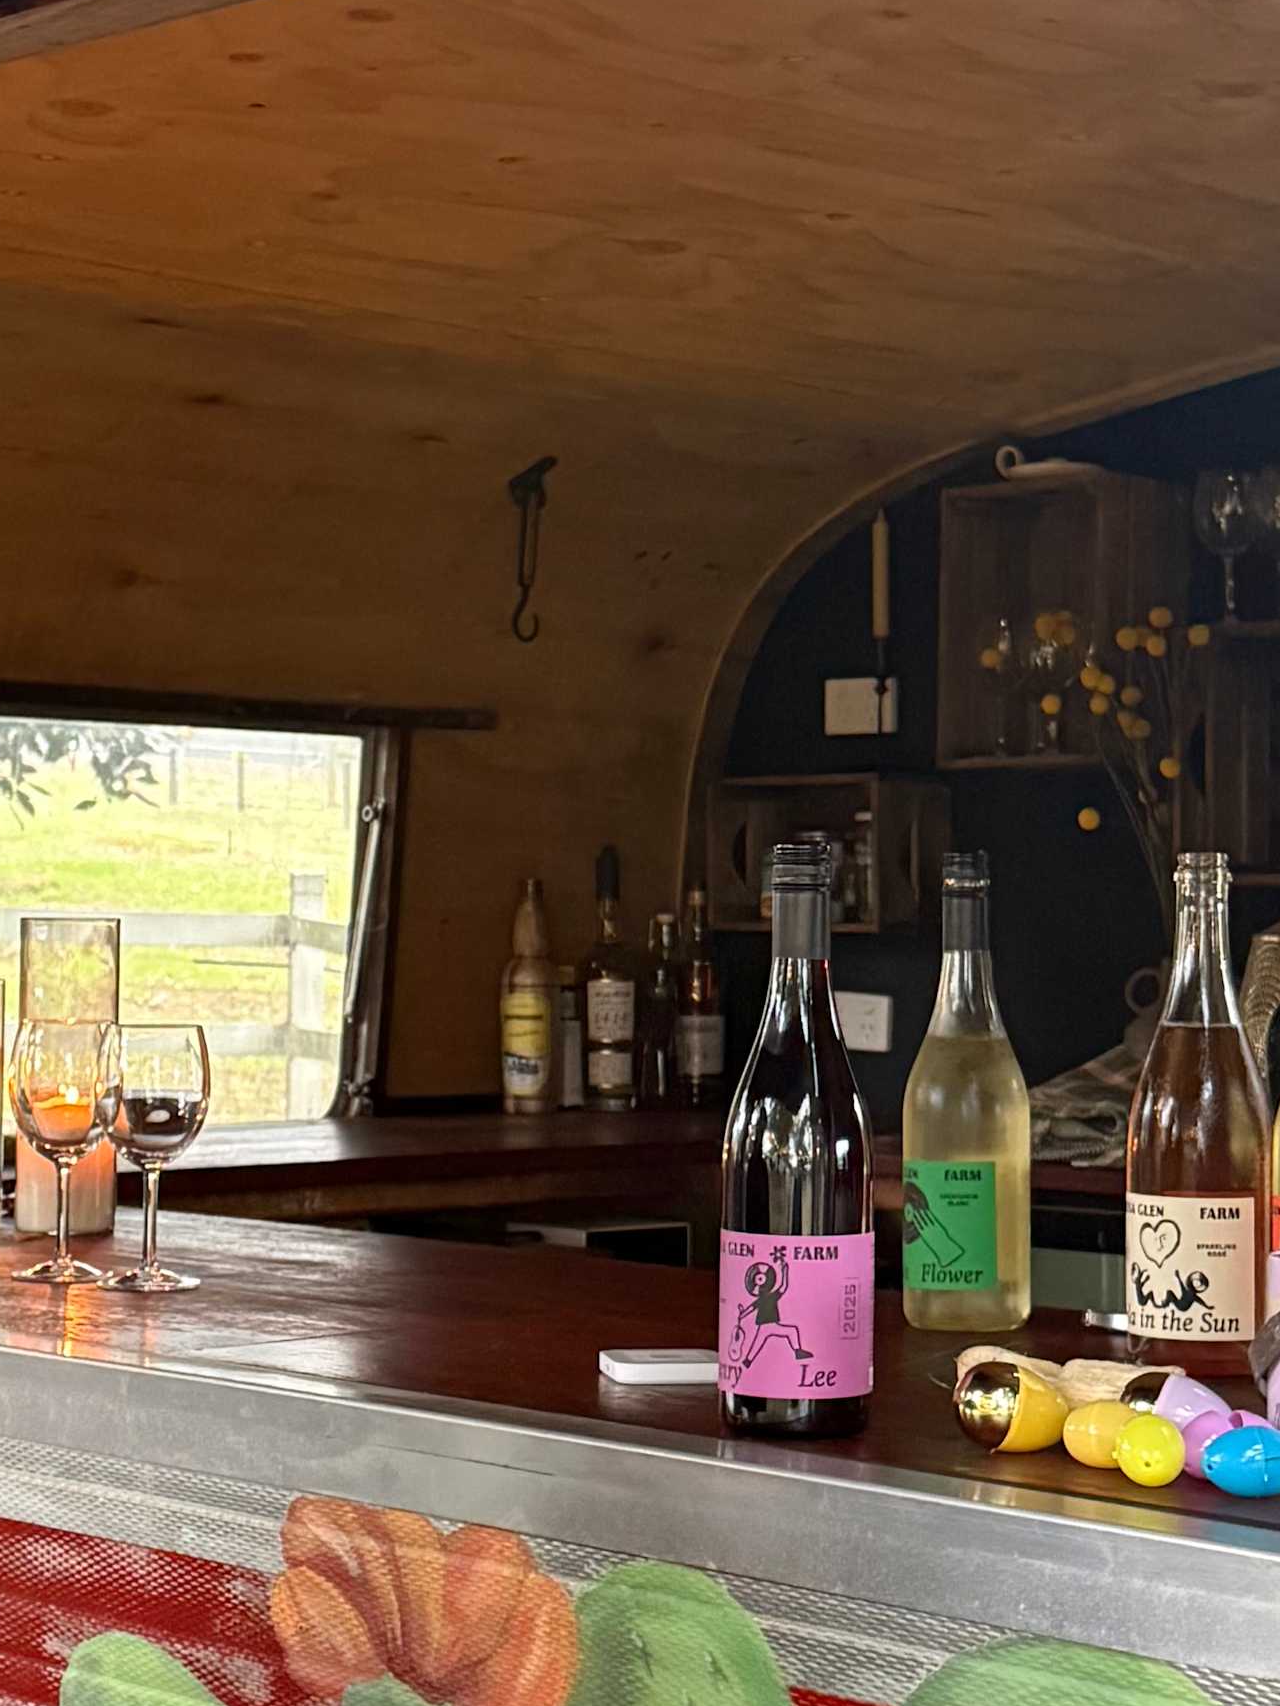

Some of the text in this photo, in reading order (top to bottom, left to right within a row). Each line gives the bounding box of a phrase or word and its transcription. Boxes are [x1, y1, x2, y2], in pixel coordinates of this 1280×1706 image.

[943, 1169, 983, 1182] FARM
[1137, 1203, 1164, 1217] GLEN
[1199, 1207, 1240, 1220] FARM
[728, 1242, 755, 1258] GLEN
[793, 1245, 839, 1260] FARM
[921, 1263, 984, 1284] Flower
[843, 1284, 857, 1334] 2025
[1140, 1308, 1155, 1328] in
[1161, 1309, 1194, 1332] the
[1199, 1312, 1240, 1333] Sun
[797, 1364, 838, 1387] Lee
